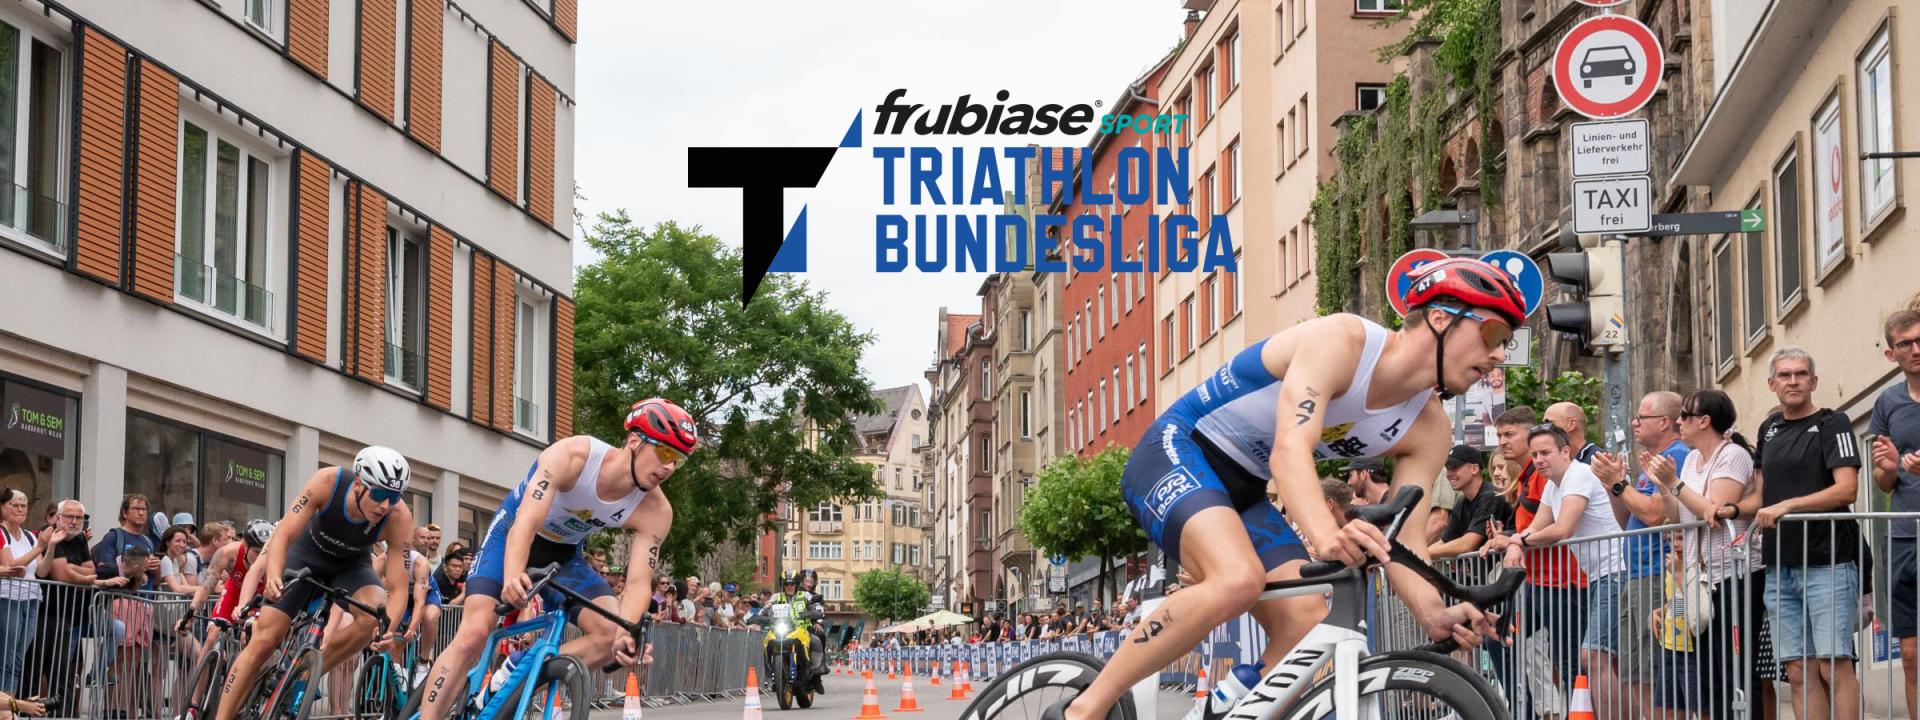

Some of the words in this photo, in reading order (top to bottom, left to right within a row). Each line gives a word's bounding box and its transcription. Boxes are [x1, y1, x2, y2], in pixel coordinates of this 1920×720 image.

[1583, 133, 1616, 143] Linien-
[1619, 131, 1637, 140] und
[1577, 143, 1644, 155] Lieferverkehr
[1602, 157, 1619, 165] frei
[1583, 187, 1639, 210] TAXI
[1600, 214, 1624, 226] frei
[1418, 277, 1430, 291] 47
[1605, 330, 1618, 339] 22
[22, 408, 39, 424] TOM
[46, 415, 63, 430] SEM
[682, 421, 693, 431] 48
[236, 464, 248, 478] TOM
[253, 469, 265, 482] SEM
[389, 480, 401, 489] 36
[532, 479, 550, 500] 48
[292, 495, 309, 514] 36
[1157, 482, 1194, 516] Bank
[1397, 666, 1436, 679] ZIPP
[428, 676, 445, 702] 48
